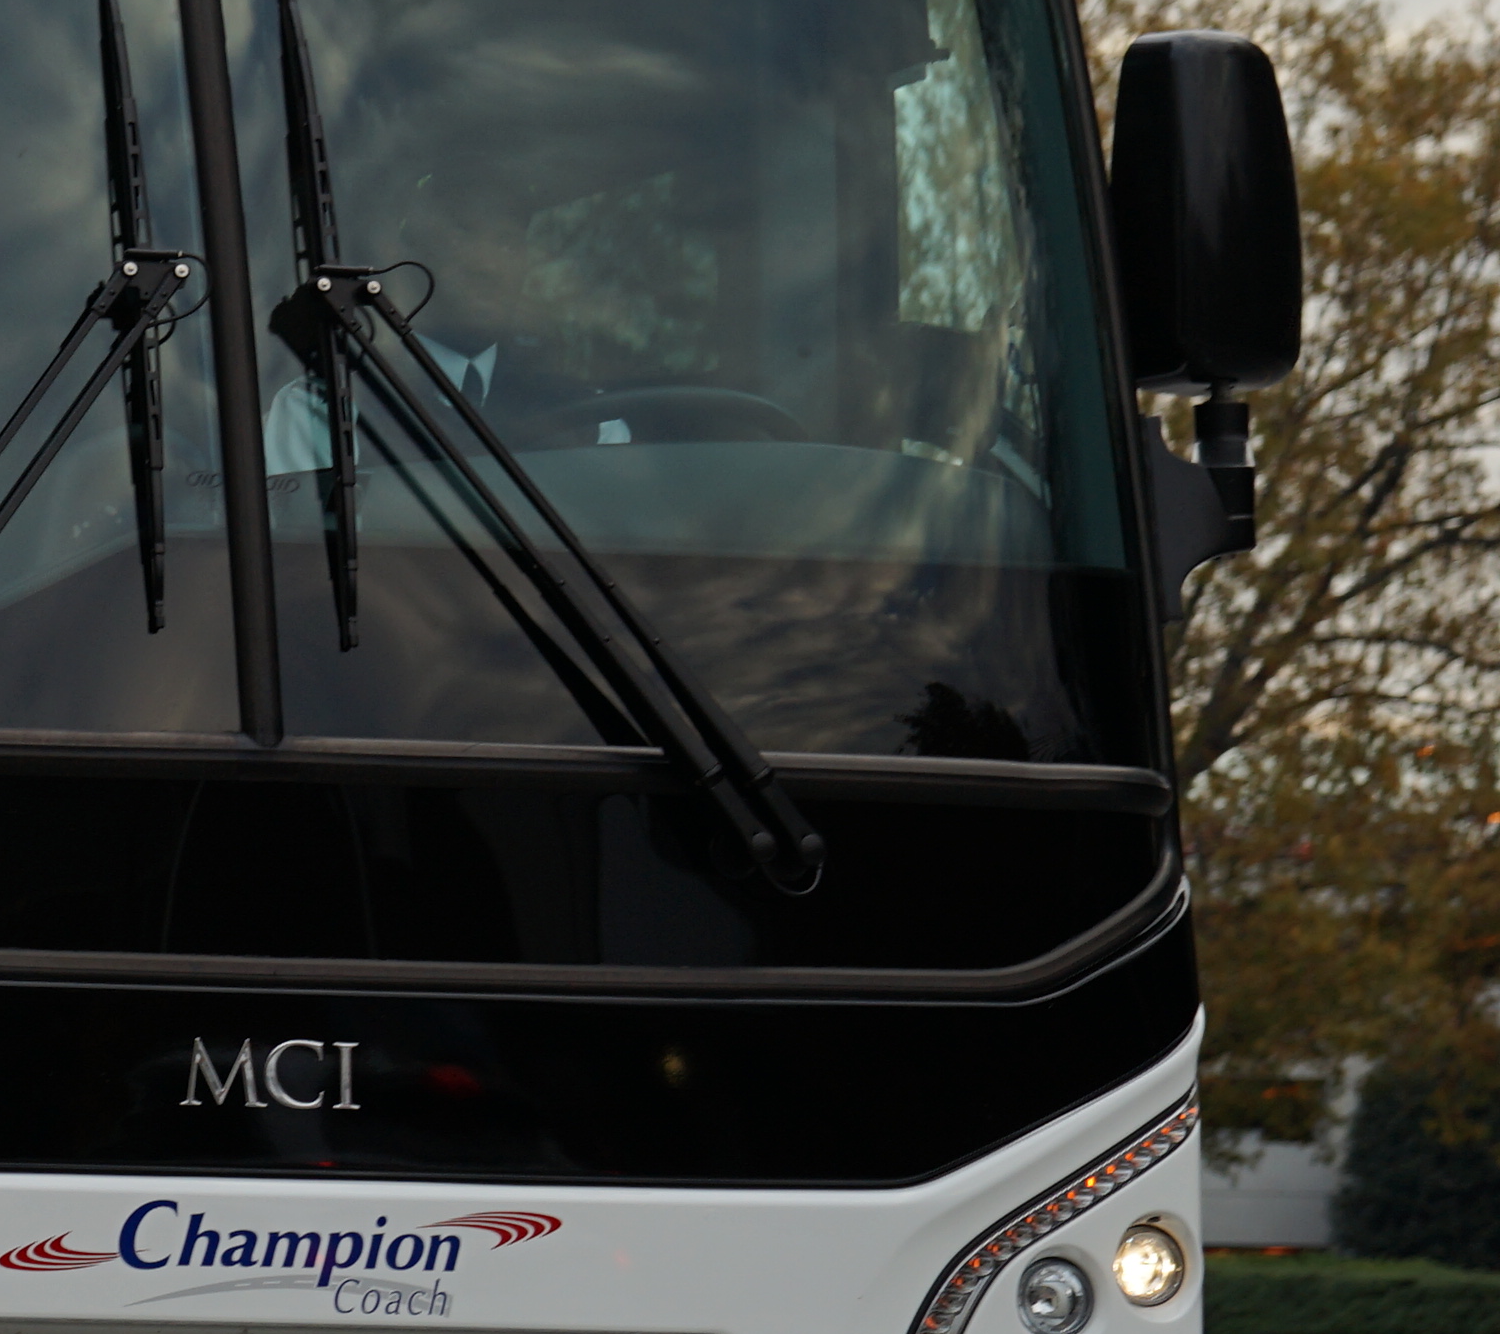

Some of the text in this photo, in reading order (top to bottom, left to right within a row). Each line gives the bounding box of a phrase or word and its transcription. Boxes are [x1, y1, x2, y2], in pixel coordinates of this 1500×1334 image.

[179, 1037, 361, 1110] MCI
[118, 1199, 461, 1287] Champion
[334, 1278, 449, 1316] Coach
